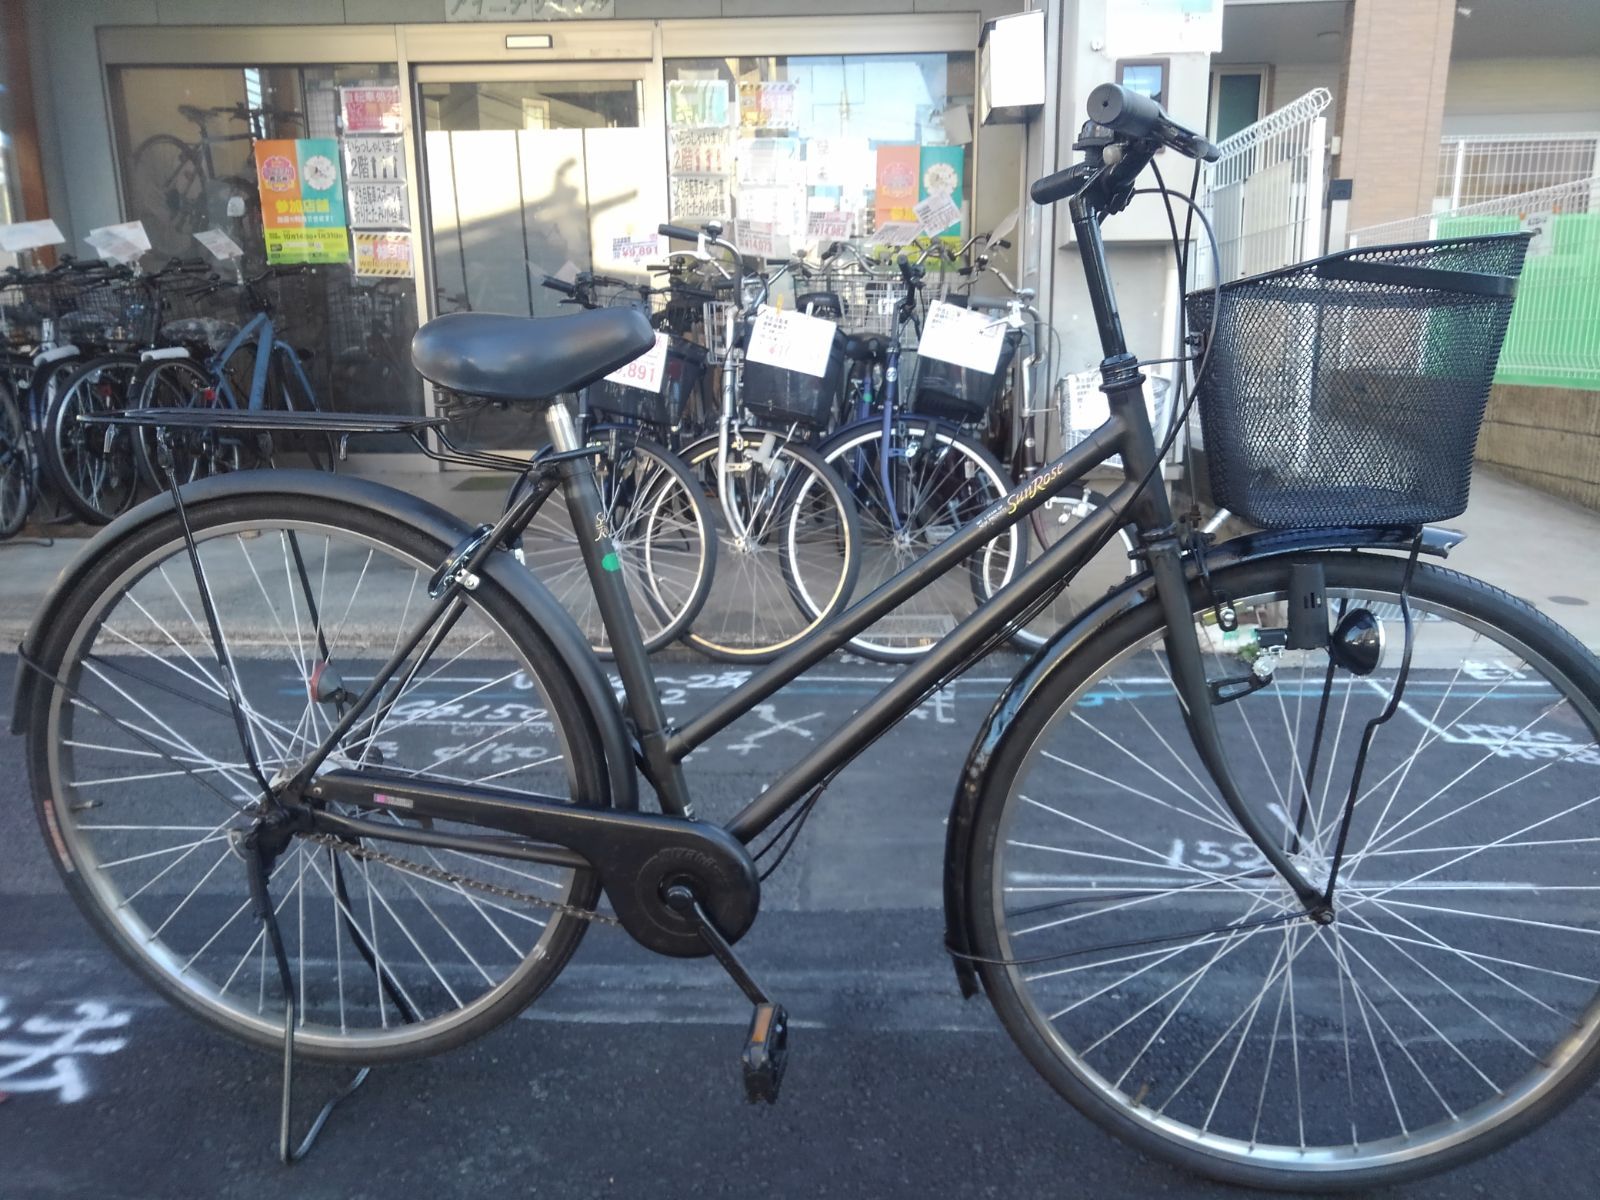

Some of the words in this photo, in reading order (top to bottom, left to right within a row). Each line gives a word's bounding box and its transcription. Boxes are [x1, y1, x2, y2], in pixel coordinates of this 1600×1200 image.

[347, 139, 399, 153] いらっしゃいませ
[351, 155, 369, 179] 2階
[674, 147, 692, 171] 2階
